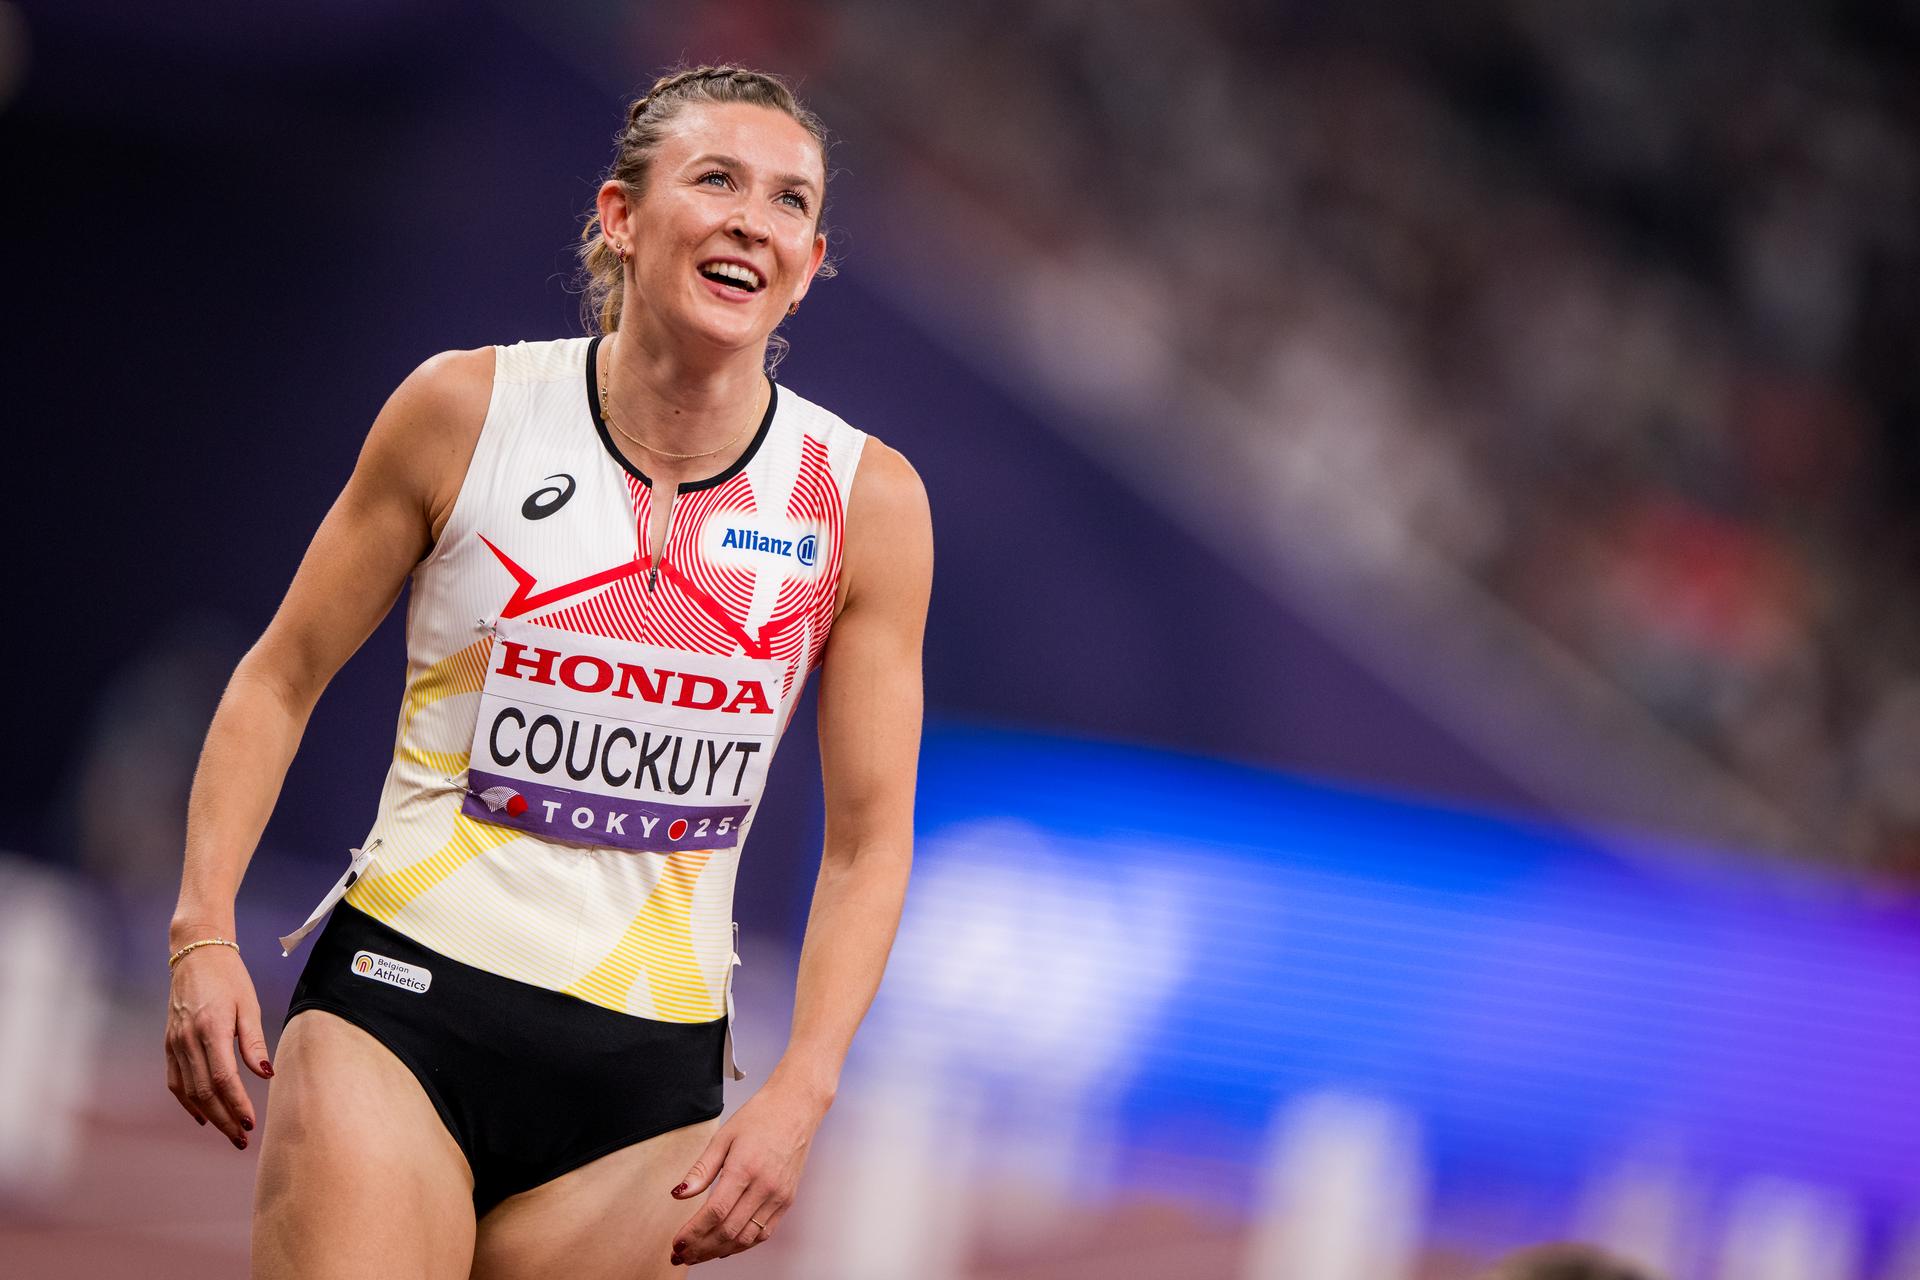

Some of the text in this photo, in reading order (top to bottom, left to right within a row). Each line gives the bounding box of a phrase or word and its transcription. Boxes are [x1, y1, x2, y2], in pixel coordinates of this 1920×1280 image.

[722, 528, 792, 557] Allianz
[496, 641, 774, 714] HONDA
[489, 707, 761, 796] COUCKUYT
[374, 968, 426, 991] Athletics
[377, 959, 409, 973] Belgian
